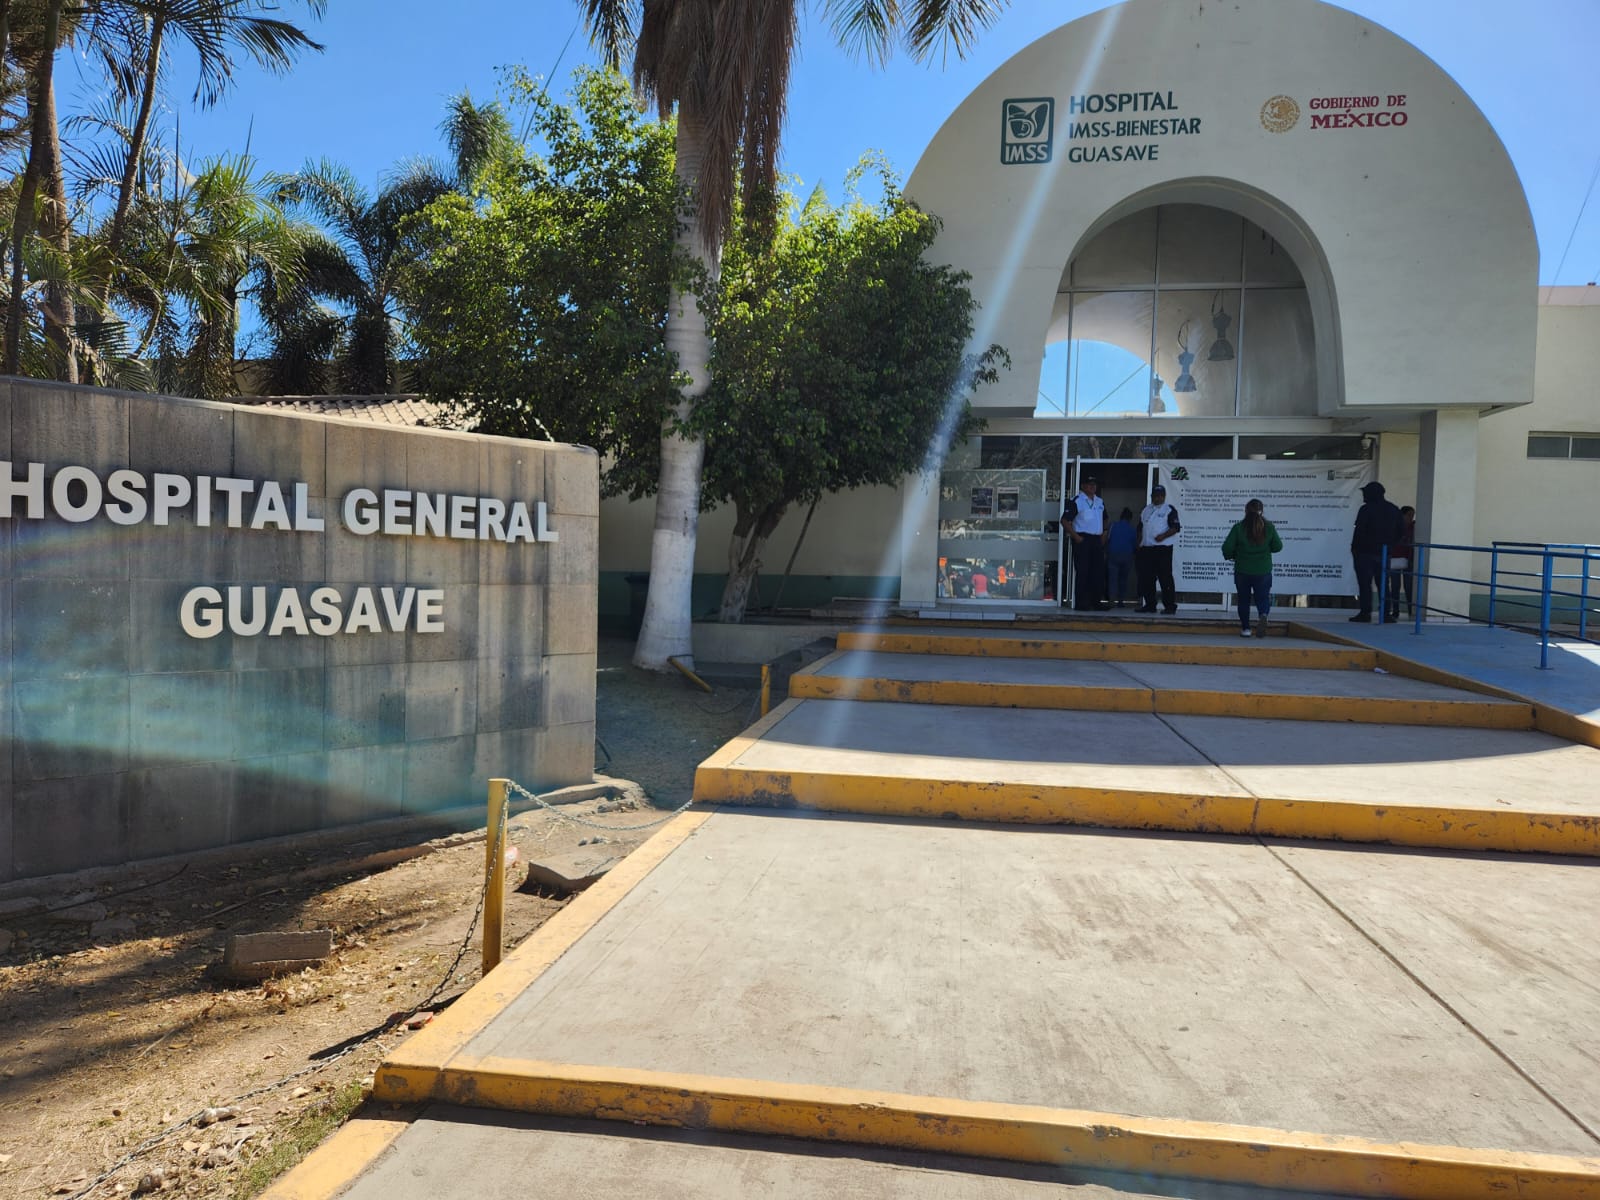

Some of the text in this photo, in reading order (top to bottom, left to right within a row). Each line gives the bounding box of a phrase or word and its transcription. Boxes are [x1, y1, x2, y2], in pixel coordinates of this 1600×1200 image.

[1069, 91, 1178, 114] HOSPITAL
[1309, 94, 1407, 110] GOBIERNO DE
[1069, 117, 1202, 140] IMSS-BIENESTAR
[1310, 108, 1408, 130] MÉXICO
[1004, 143, 1049, 163] IMSS
[1068, 144, 1160, 164] GUASAVE
[0, 461, 560, 544] HOSPITAL GENERAL
[180, 586, 446, 640] GUASAVE
